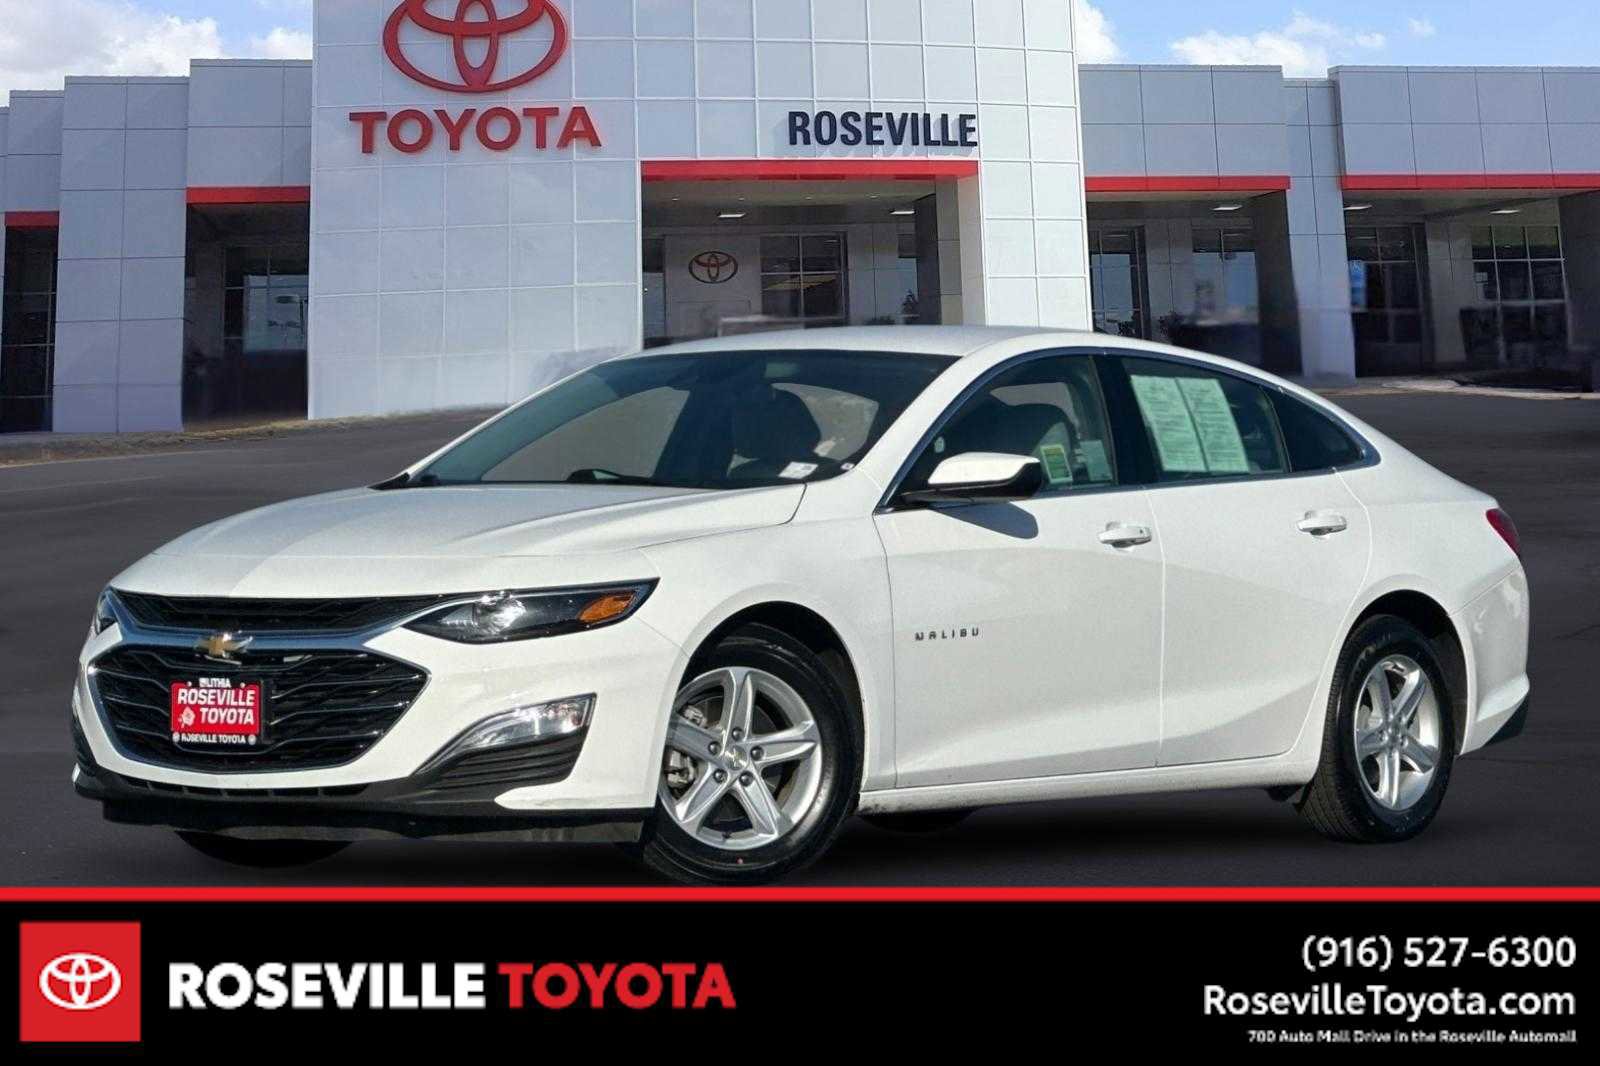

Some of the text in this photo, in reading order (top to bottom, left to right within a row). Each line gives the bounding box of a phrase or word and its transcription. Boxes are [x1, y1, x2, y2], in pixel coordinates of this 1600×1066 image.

[349, 106, 603, 154] TOYOTA
[788, 110, 978, 147] ROSEVILLE
[177, 688, 256, 706] ROSEVILLE
[199, 707, 255, 725] TOYOTA
